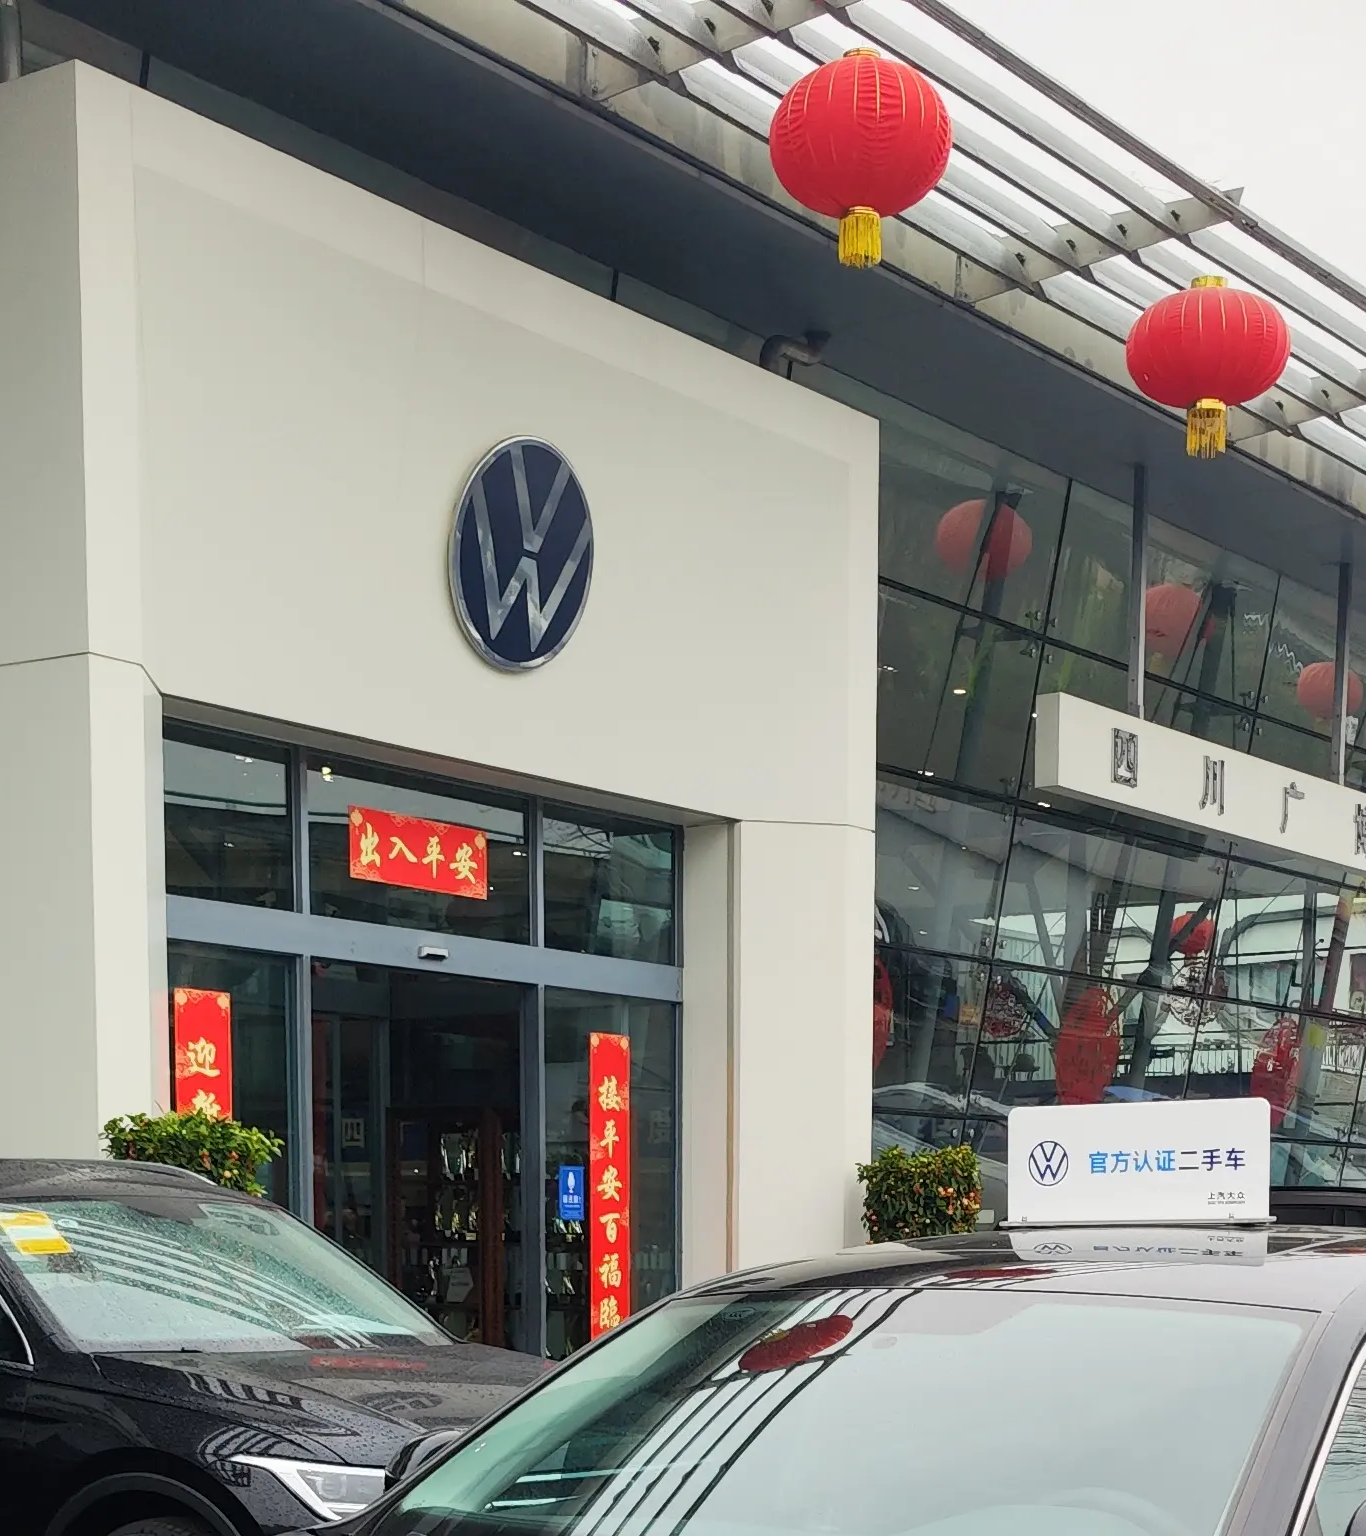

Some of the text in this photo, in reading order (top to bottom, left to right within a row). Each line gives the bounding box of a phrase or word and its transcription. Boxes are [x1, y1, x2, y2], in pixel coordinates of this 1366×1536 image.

[359, 822, 479, 885] 出入平安
[1028, 1140, 1069, 1187] VW
[1088, 1147, 1246, 1174] 官方认证二手车
[1207, 1191, 1246, 1200] 上汽大众
